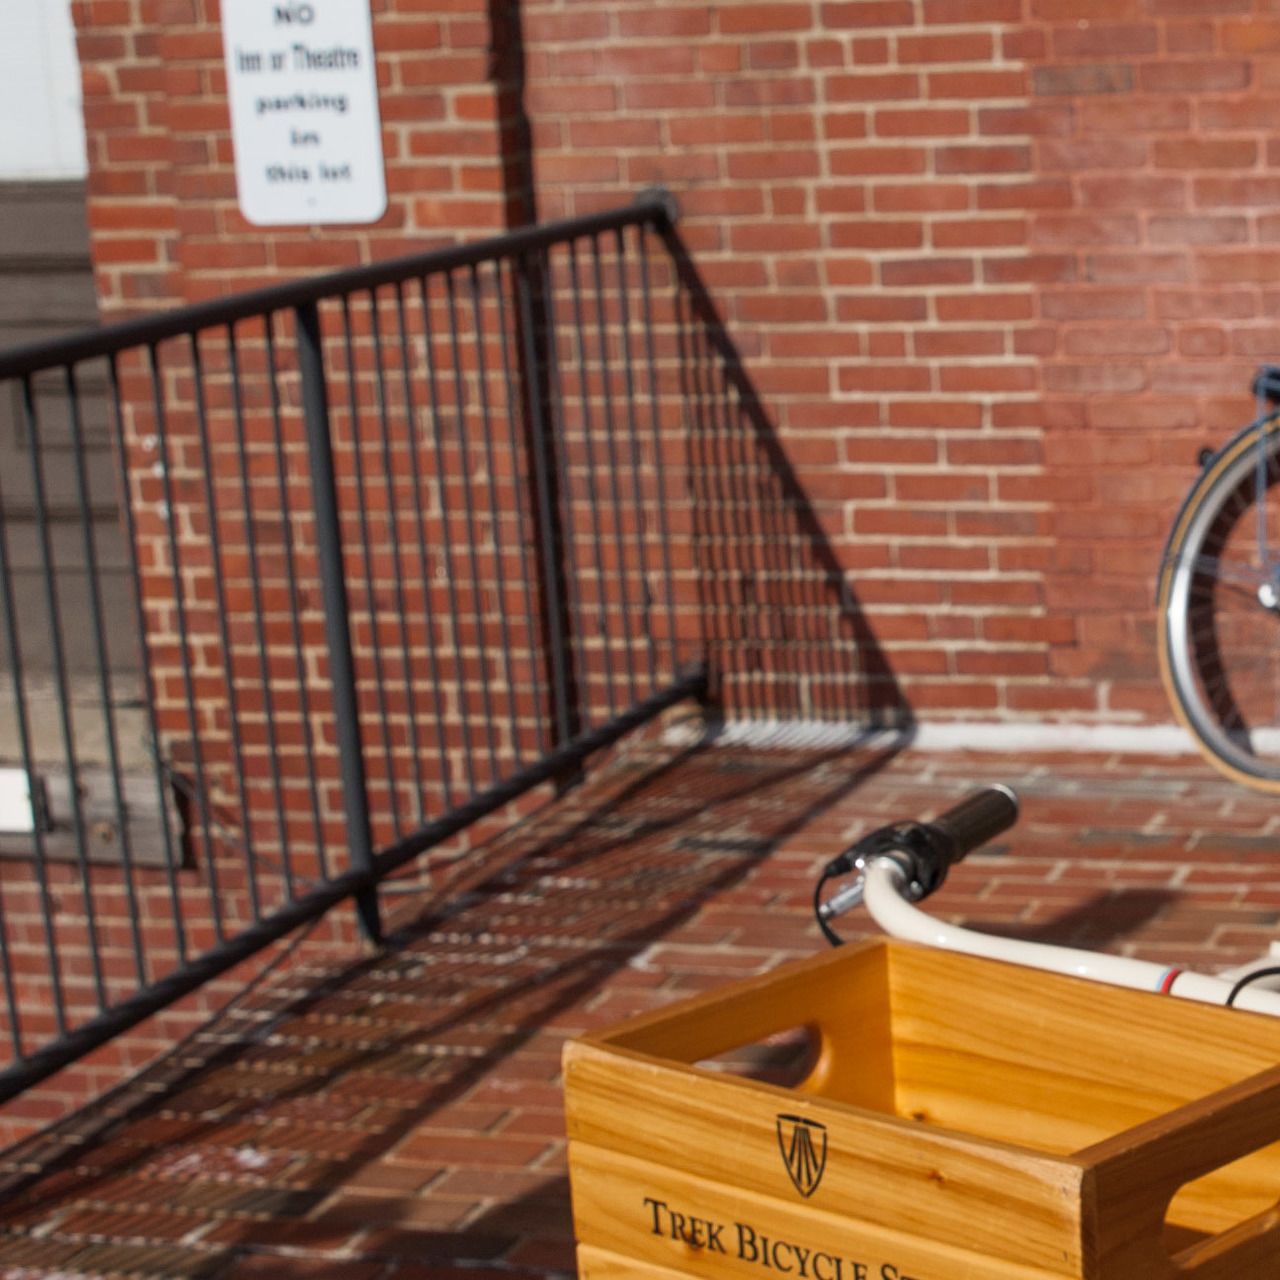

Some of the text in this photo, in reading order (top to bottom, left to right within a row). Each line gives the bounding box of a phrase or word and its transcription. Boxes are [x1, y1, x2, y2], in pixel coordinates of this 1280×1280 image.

[274, 4, 316, 26] NO
[270, 54, 286, 72] or
[291, 44, 361, 72] Theatre
[256, 93, 349, 117] parking
[265, 162, 352, 184] this lot
